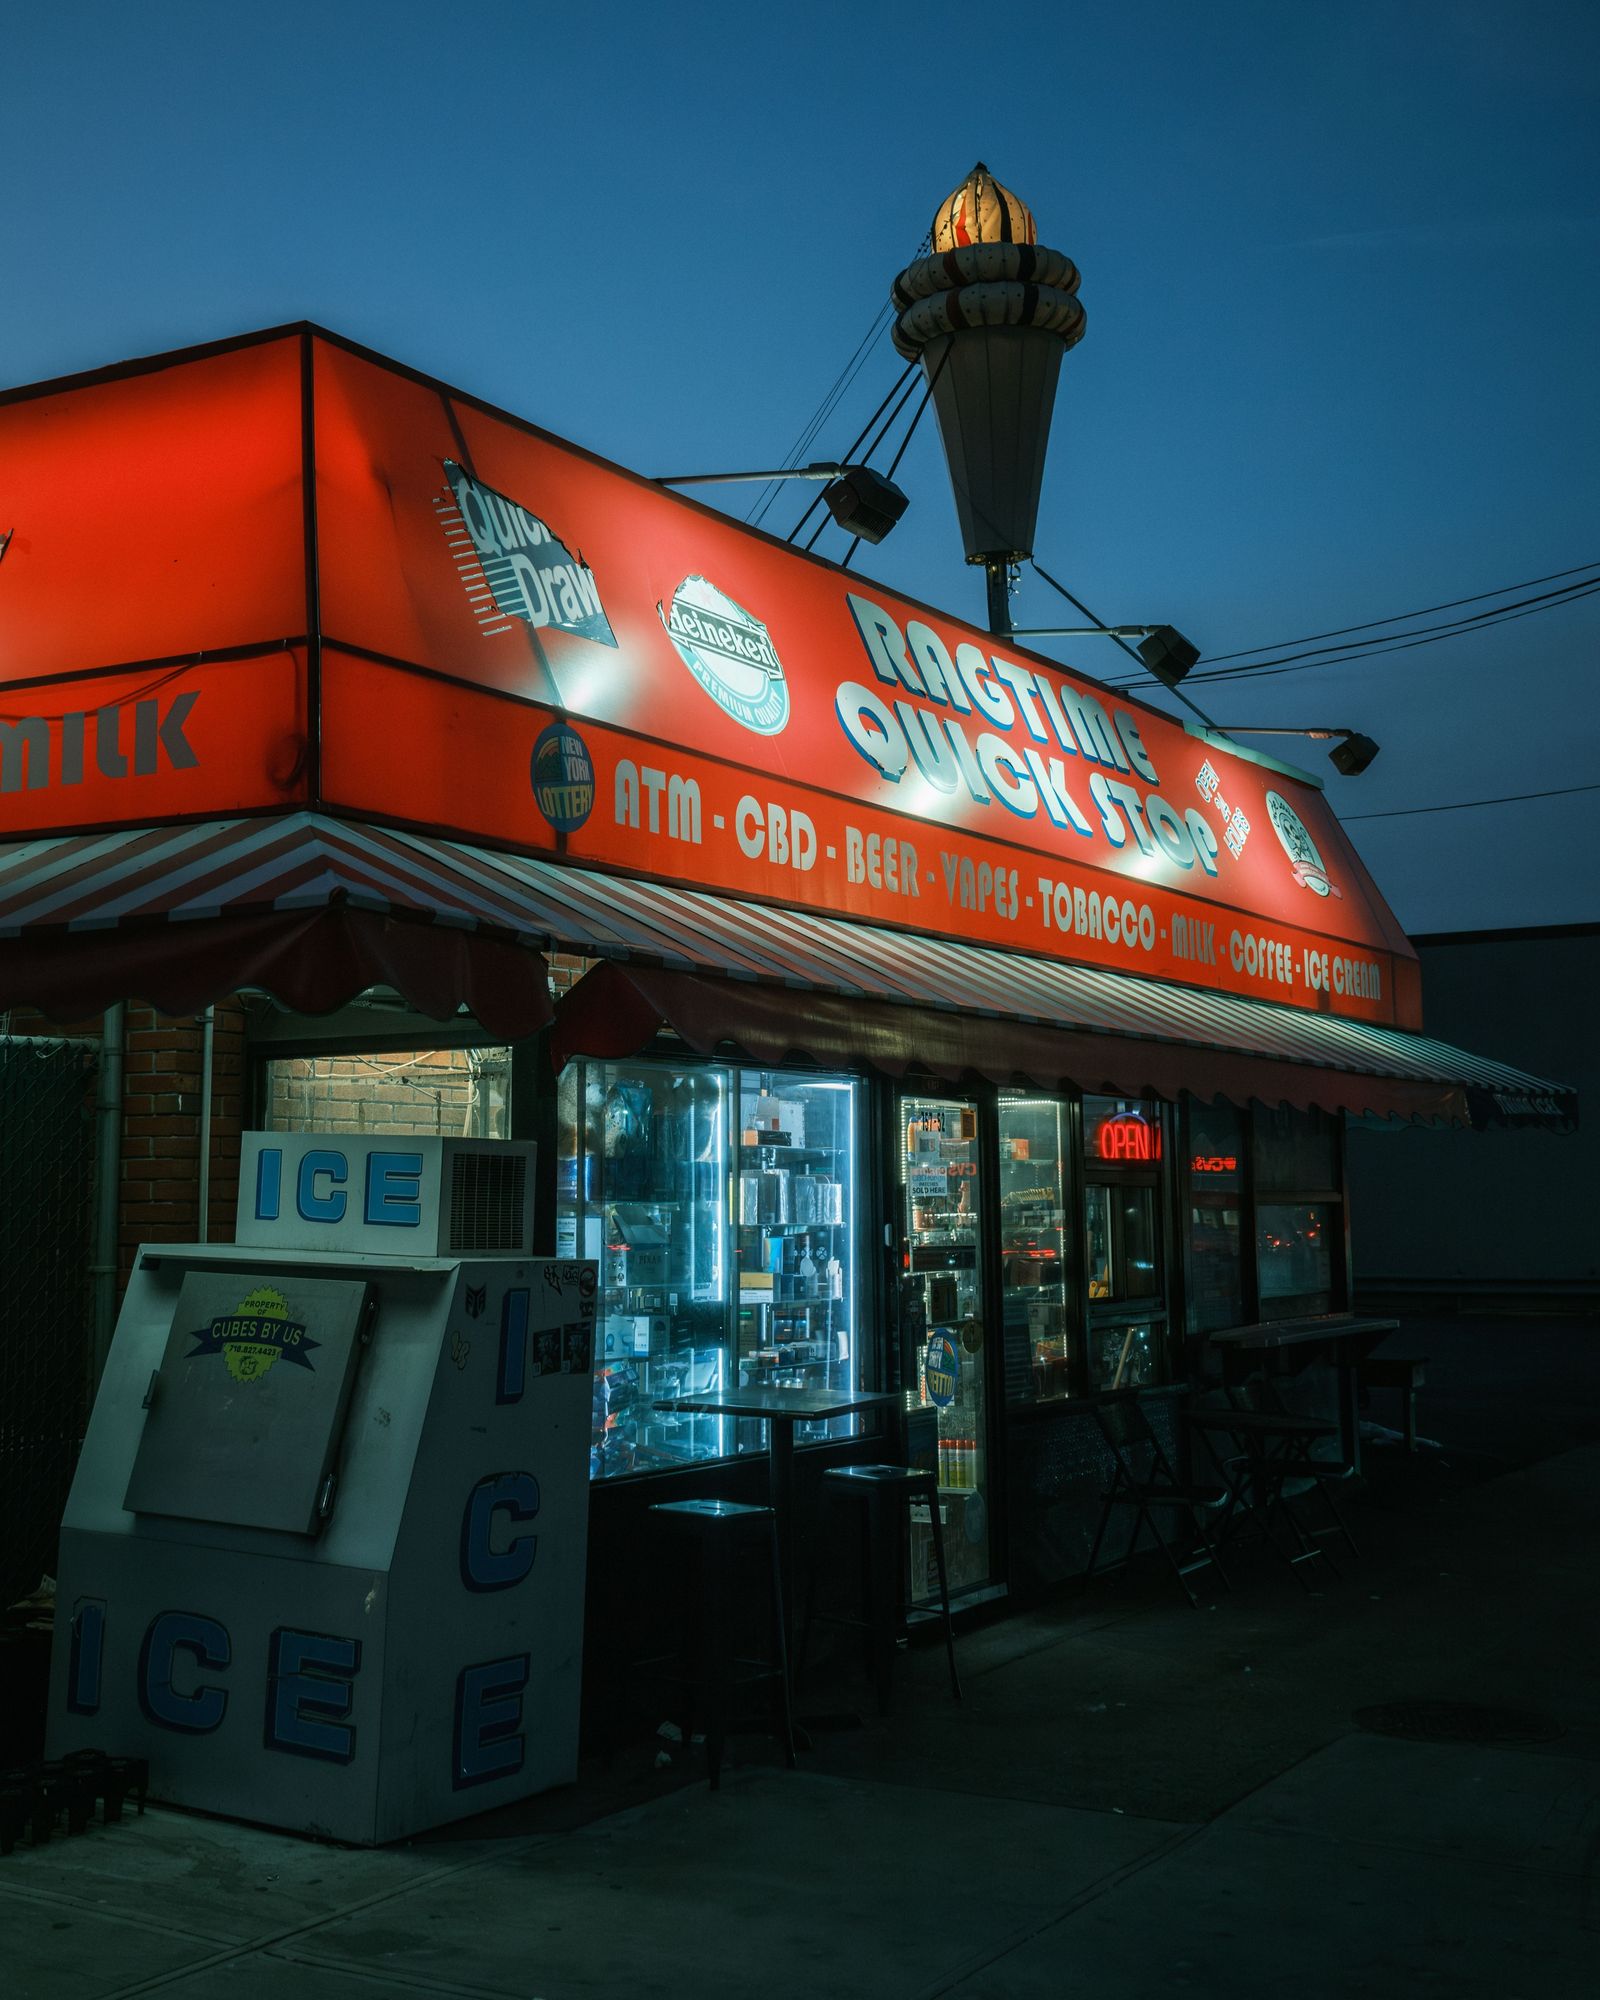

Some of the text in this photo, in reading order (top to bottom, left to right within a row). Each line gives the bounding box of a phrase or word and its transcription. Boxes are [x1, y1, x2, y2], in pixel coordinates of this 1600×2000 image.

[510, 553, 603, 629] Draw
[669, 603, 777, 668] Heineken
[692, 661, 783, 726] PREMIUM QUALITY
[846, 592, 1160, 787] RAGTIME
[560, 735, 583, 757] NEW
[564, 756, 591, 783] YORK
[536, 783, 593, 820] LOTTERY
[835, 681, 1219, 877] QUICK STOP
[1195, 758, 1220, 803] OPEN
[1213, 791, 1232, 823] 24
[1222, 807, 1251, 861] HOURS
[614, 759, 1382, 1000] ATM CBD BEER VAPES TOBACCO MILK COFFEE ICE CREAM
[1101, 1123, 1150, 1161] OPEN
[254, 1148, 424, 1228] ICE
[212, 1320, 303, 1346] CUBES BY US
[244, 1300, 285, 1311] PROPERTY
[453, 1287, 540, 1792] ICE
[67, 1596, 363, 1767] ICE
